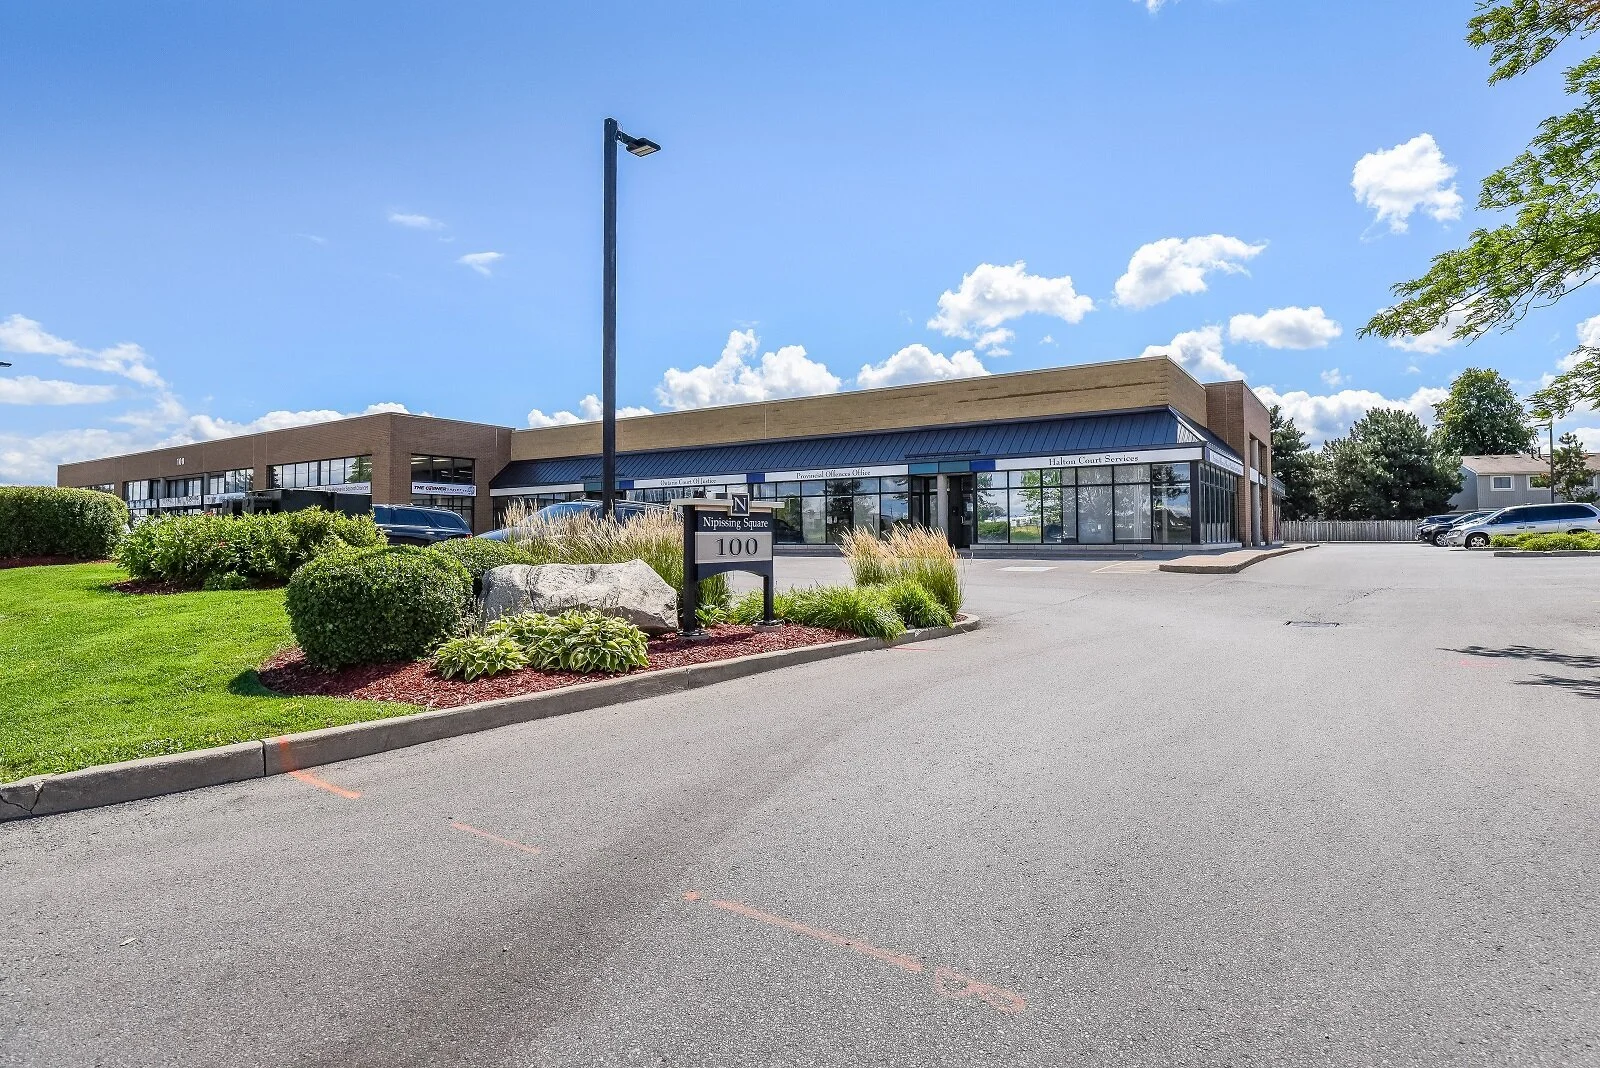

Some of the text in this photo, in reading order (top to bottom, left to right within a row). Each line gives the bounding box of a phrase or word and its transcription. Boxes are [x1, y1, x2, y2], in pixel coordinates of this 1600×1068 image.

[1049, 454, 1139, 466] Halton Court Services
[796, 468, 870, 480] Provincial Offences Office
[733, 497, 747, 512] N
[703, 516, 769, 530] Nipissing Square
[716, 537, 758, 557] 100
